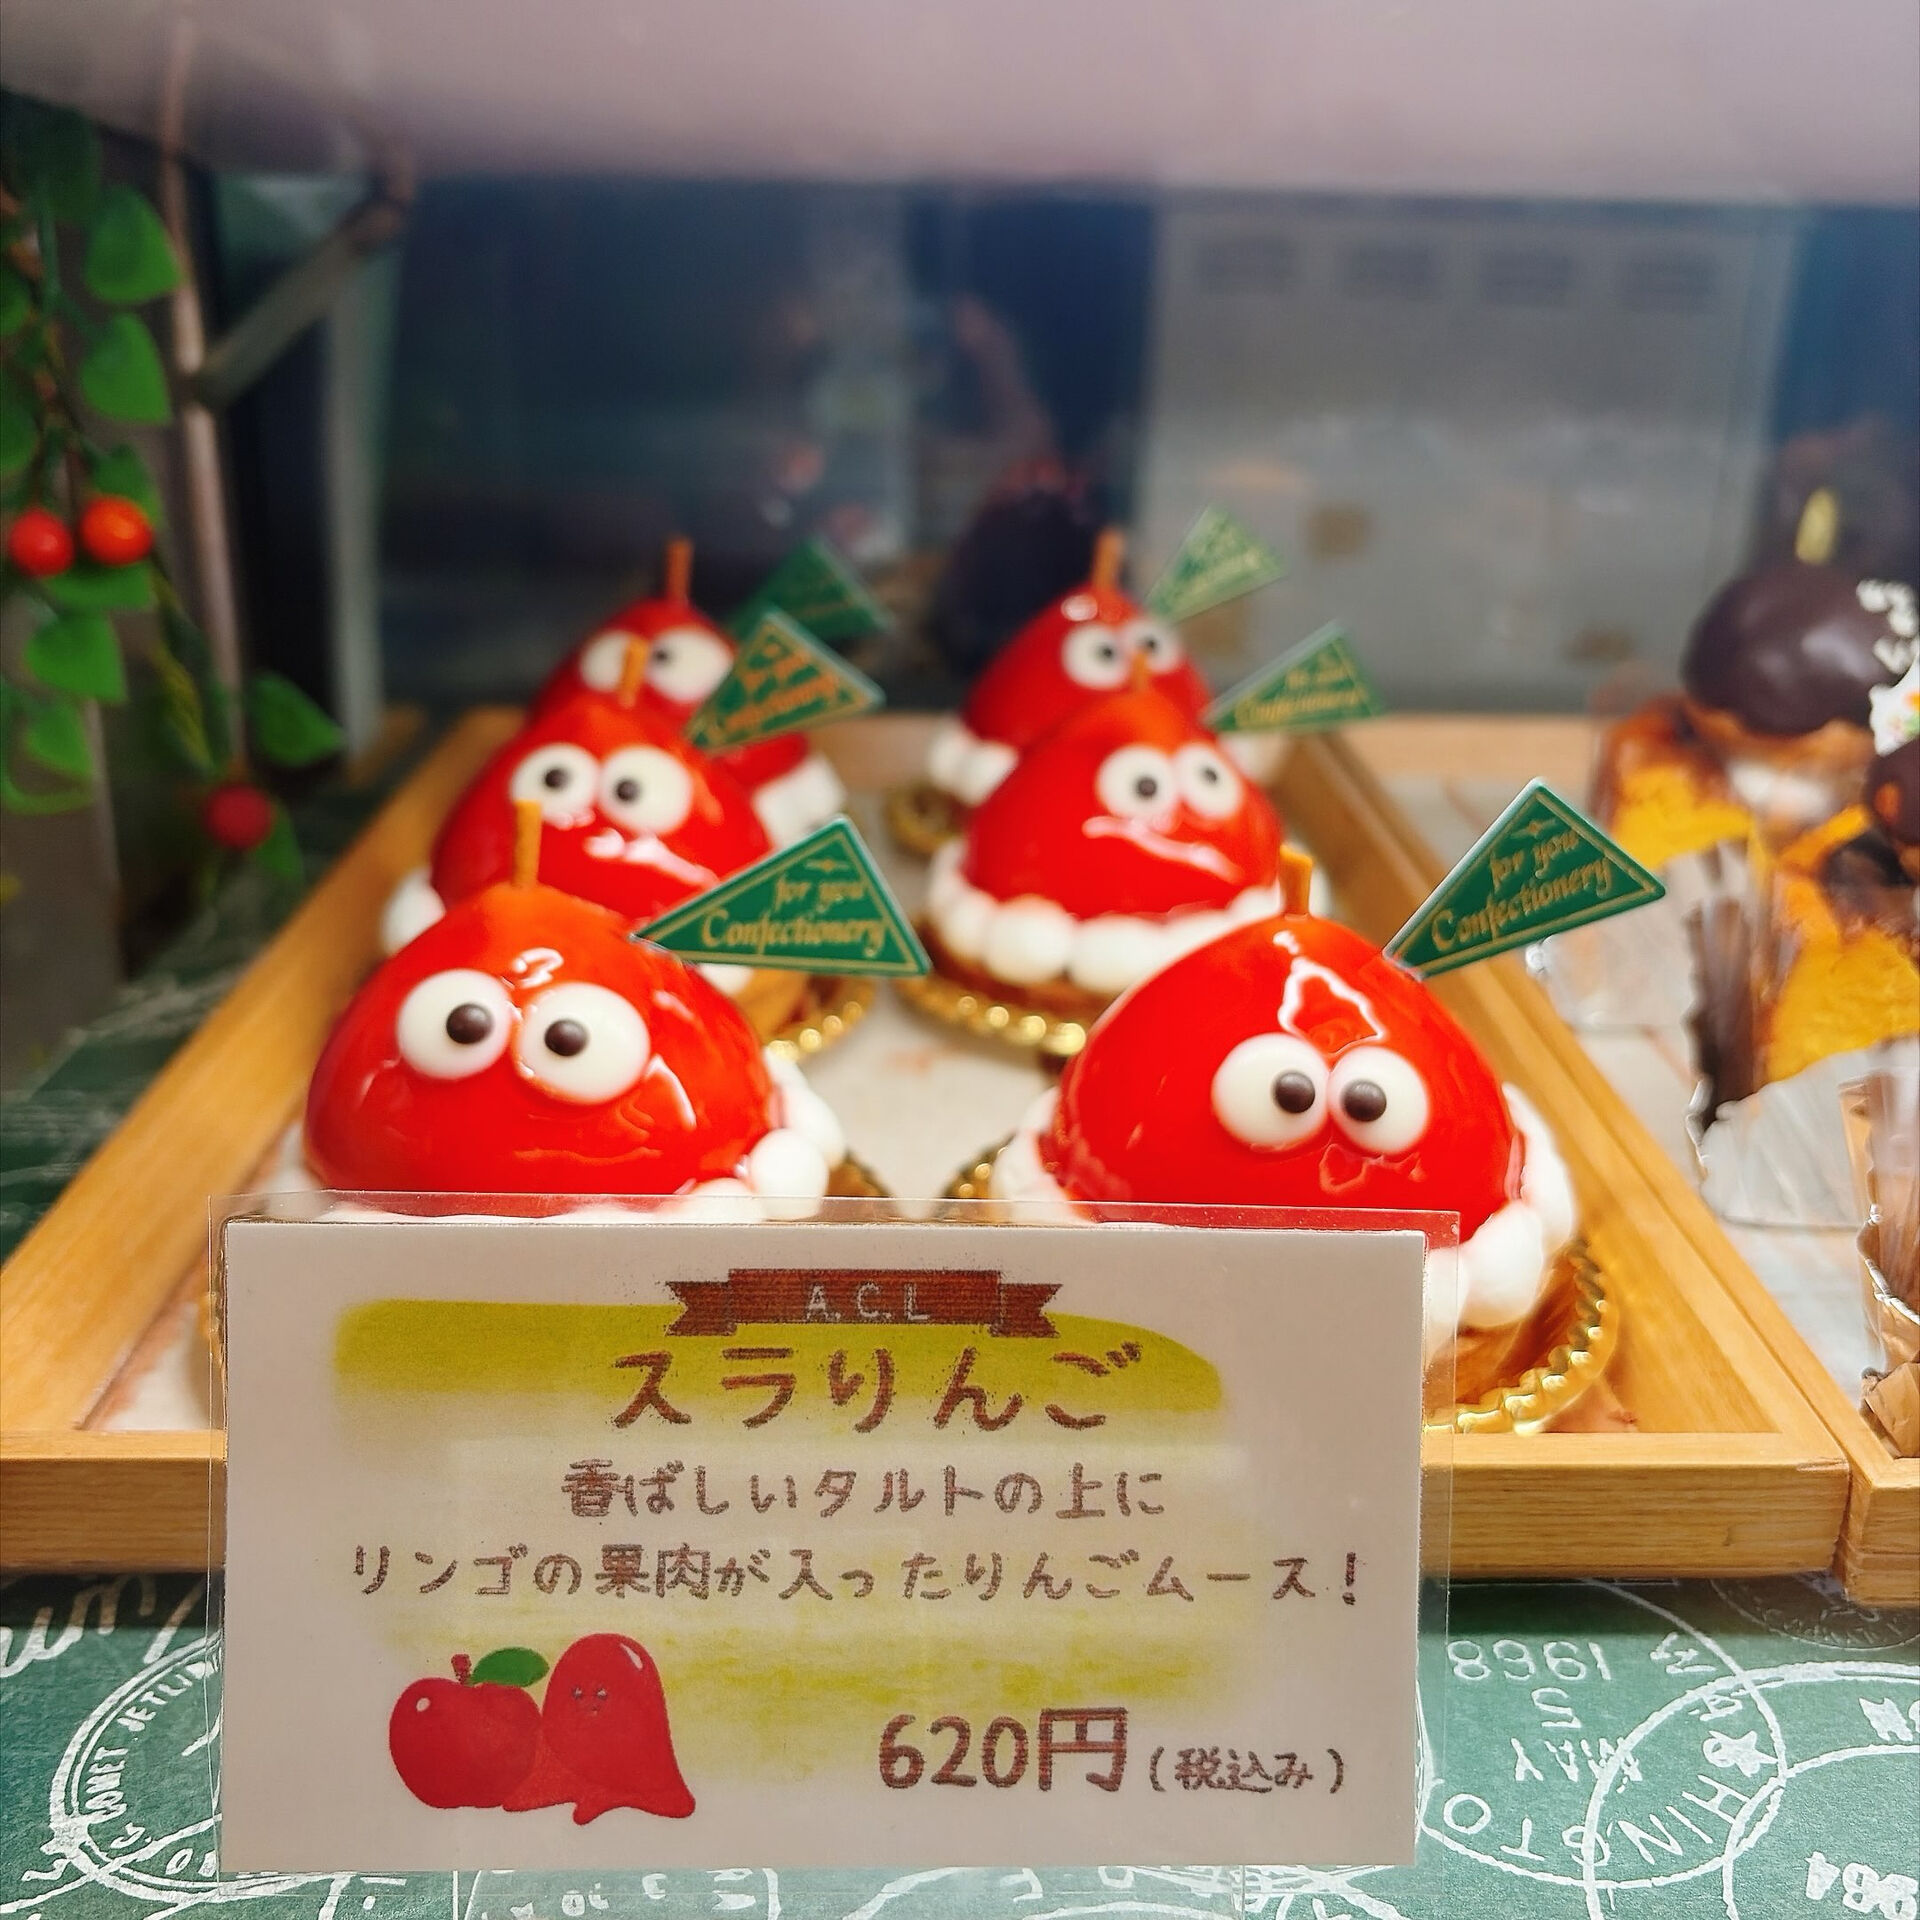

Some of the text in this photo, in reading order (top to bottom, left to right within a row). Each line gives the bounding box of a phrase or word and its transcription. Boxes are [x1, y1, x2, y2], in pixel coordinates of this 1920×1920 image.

[1532, 829, 1580, 880] you
[773, 872, 866, 914] for you
[1430, 855, 1613, 953] Confectionery
[700, 908, 887, 958] Confectionery
[613, 1340, 1143, 1433] スラりんご
[561, 1458, 1165, 1517] 香ばしいタルトの上に
[879, 1707, 1128, 1792] 620円
